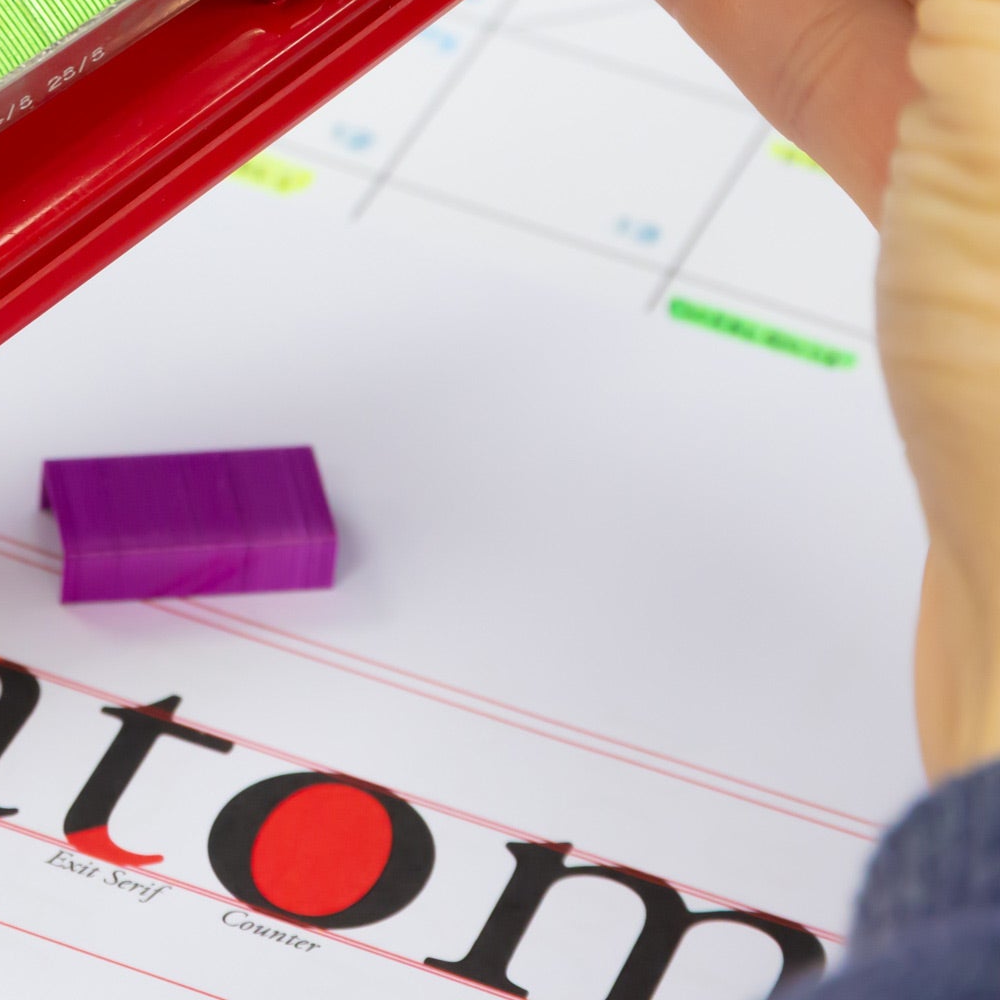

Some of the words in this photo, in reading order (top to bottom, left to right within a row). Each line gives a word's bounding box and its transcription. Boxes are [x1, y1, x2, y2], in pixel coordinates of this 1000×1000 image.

[46, 850, 99, 878] Exit
[103, 869, 173, 903] Serif
[221, 910, 321, 953] Counter
